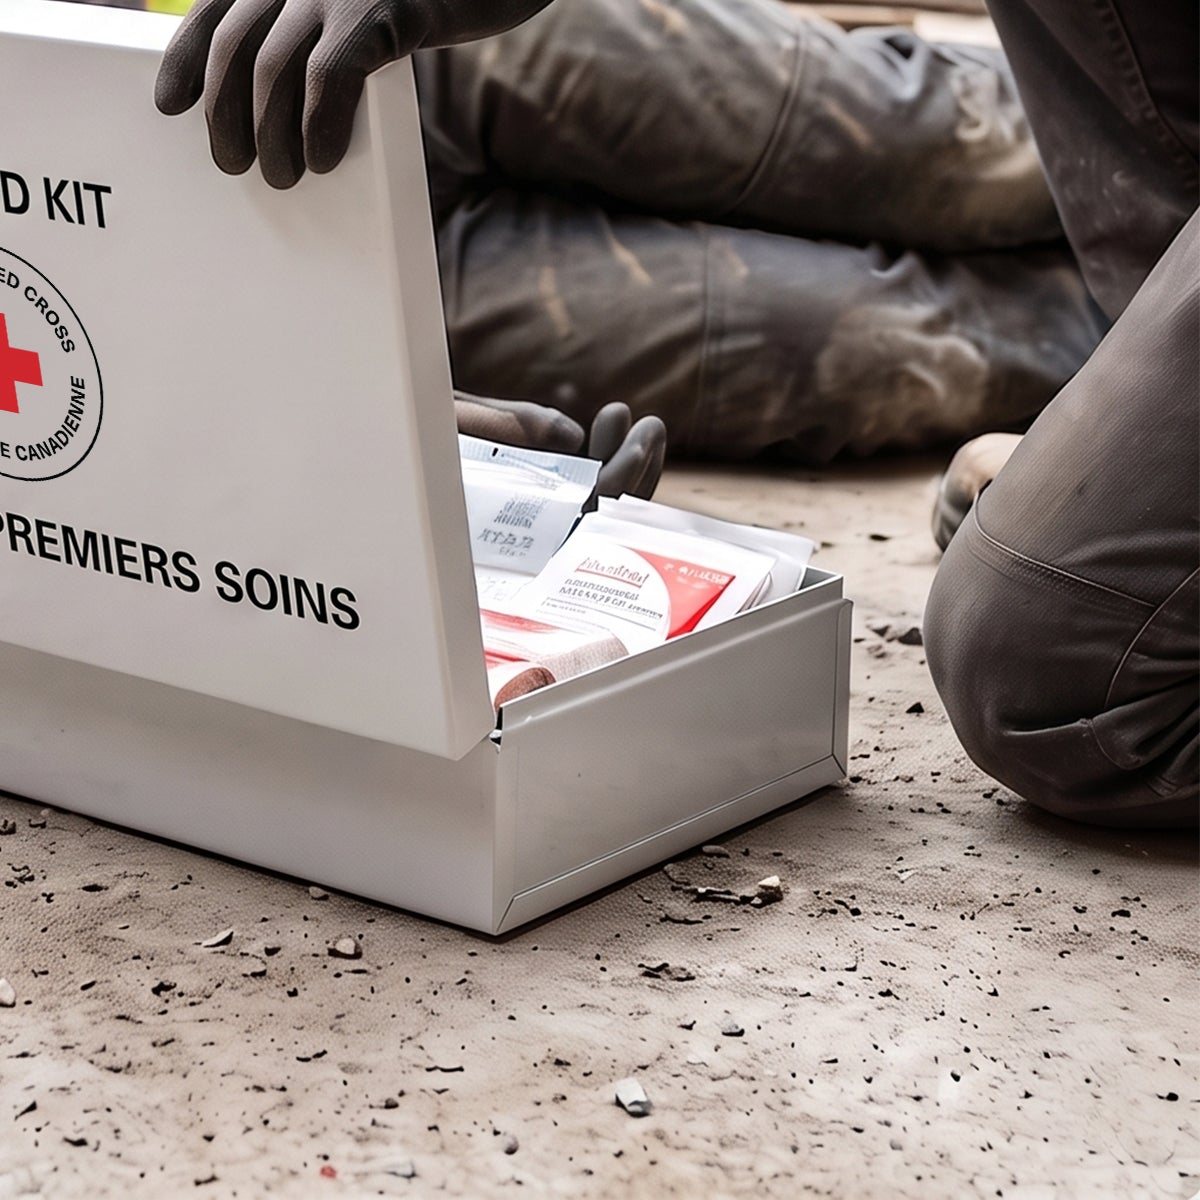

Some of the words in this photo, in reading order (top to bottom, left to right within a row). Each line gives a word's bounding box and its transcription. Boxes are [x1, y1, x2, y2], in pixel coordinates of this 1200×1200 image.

[42, 176, 112, 229] KIT
[23, 285, 76, 353] CROSS
[14, 375, 86, 462] CANADIENNE
[214, 560, 361, 631] SOINS
